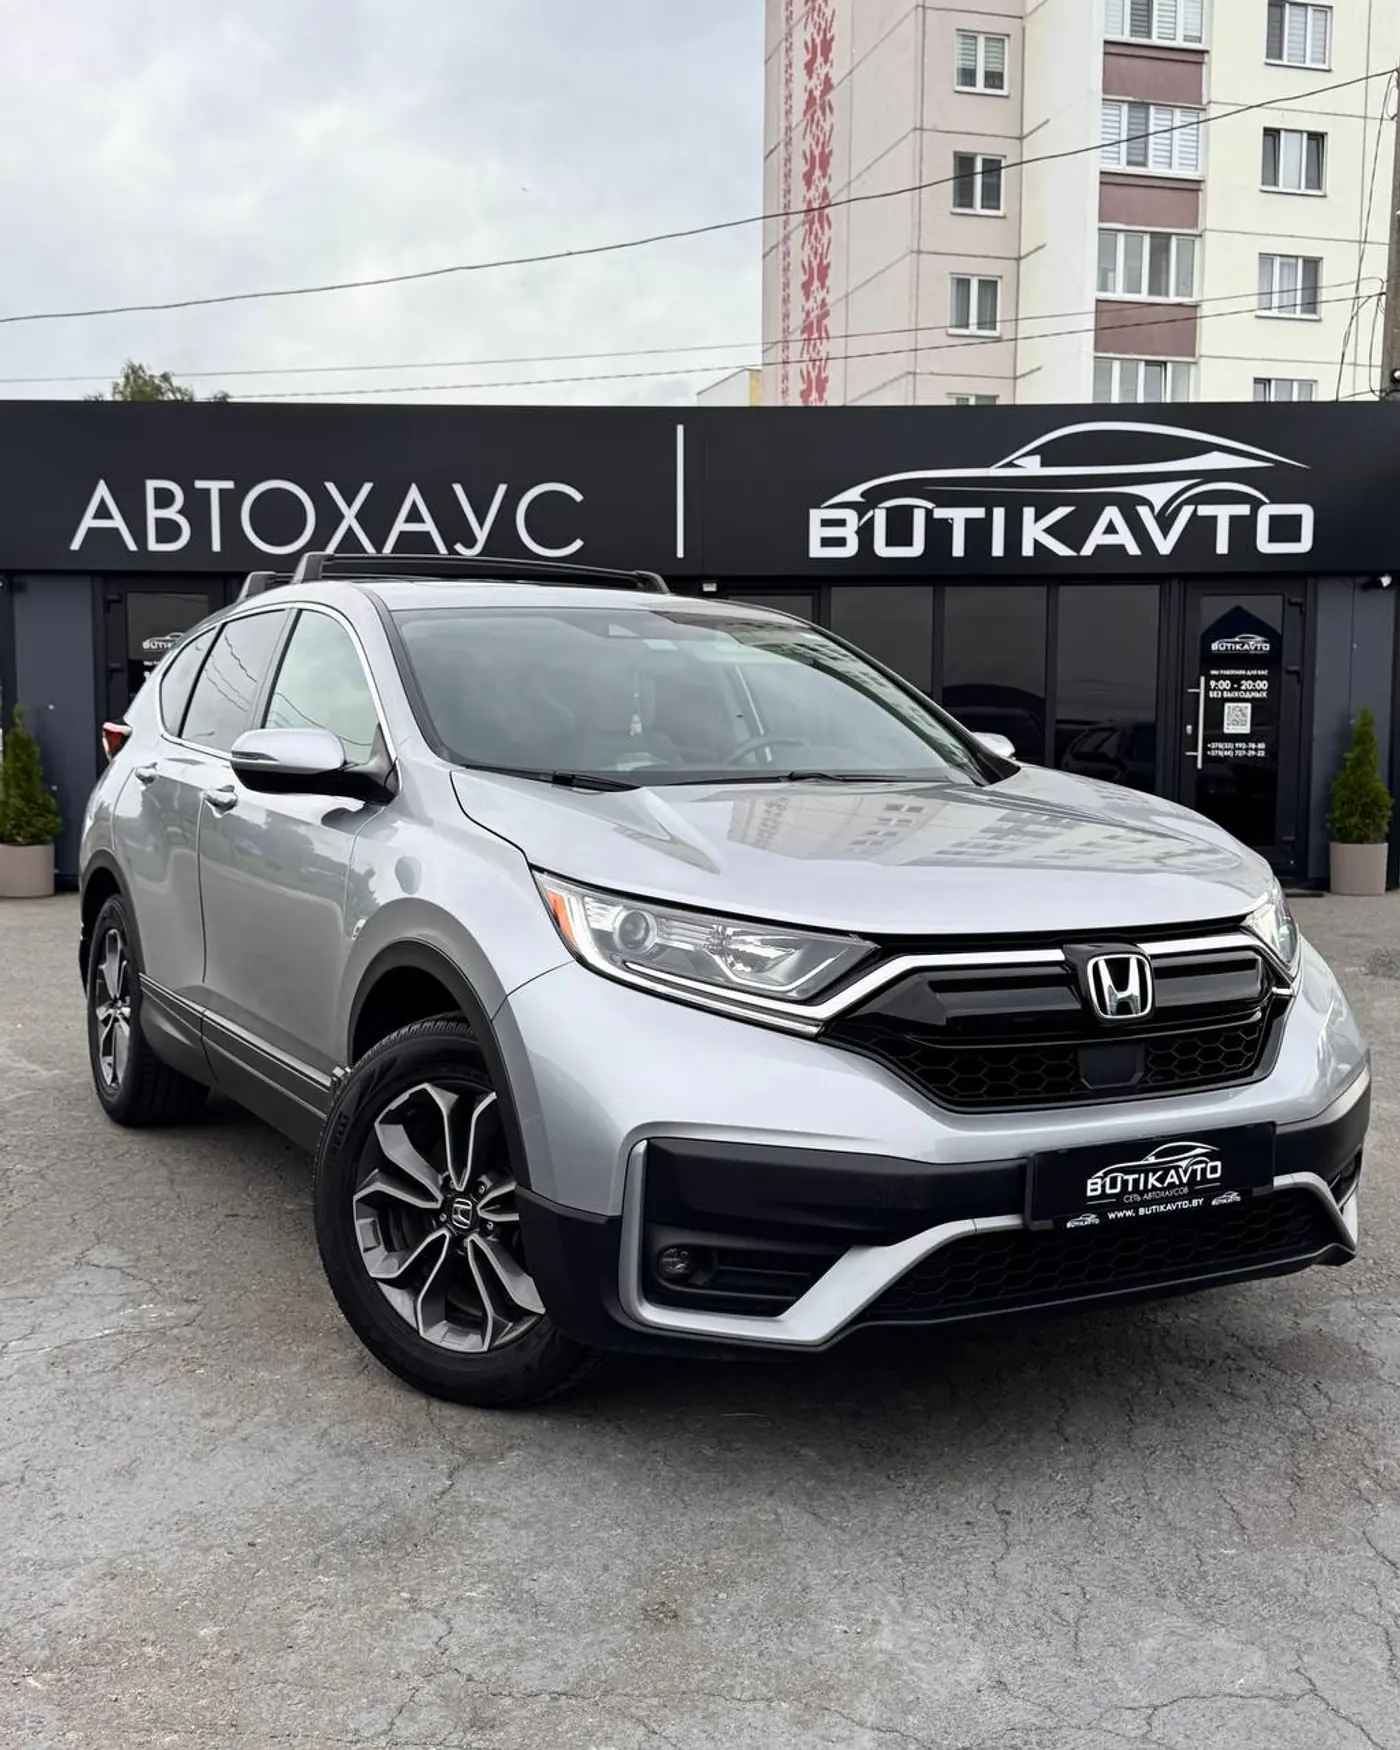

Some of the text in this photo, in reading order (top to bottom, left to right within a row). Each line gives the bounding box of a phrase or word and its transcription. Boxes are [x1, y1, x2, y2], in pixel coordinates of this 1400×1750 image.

[70, 478, 586, 558] АВТОХАУС
[809, 503, 1314, 559] BUTIKAVTO
[1211, 642, 1270, 651] BUTIKAVTO
[1209, 680, 1231, 690] 9:00
[1240, 680, 1268, 690] 20:00
[1223, 691, 1268, 699] ВЫХОДНЫХ
[1086, 1161, 1222, 1197] BUTIKAVTO
[1122, 1186, 1189, 1203] СЕТЬ АВТОХАУСОВ
[1107, 1198, 1204, 1220] WWW. BUTIKAVTO.BY
